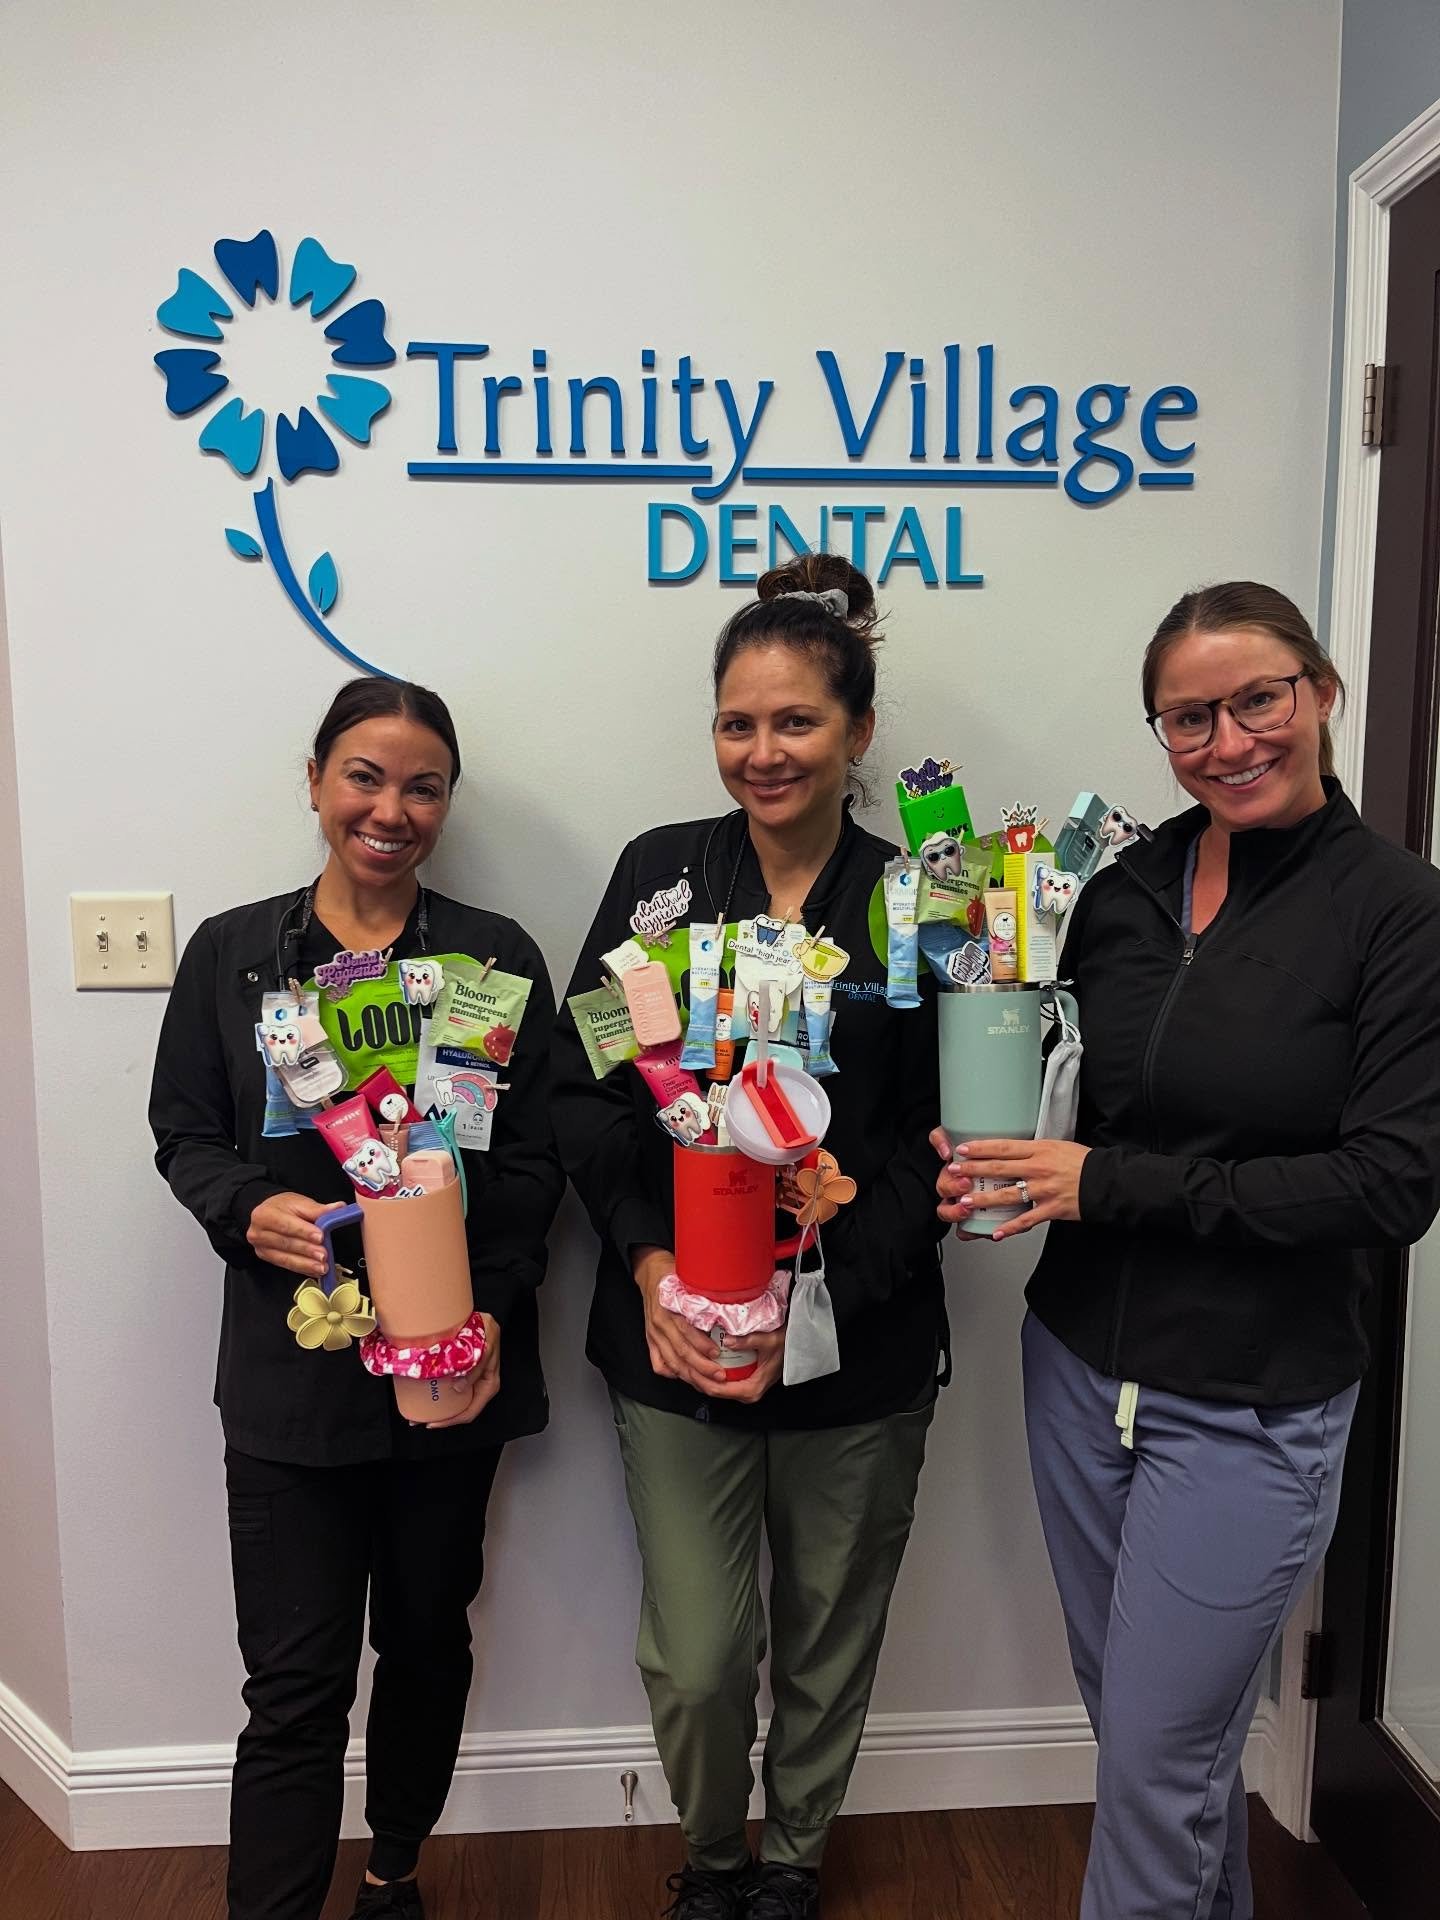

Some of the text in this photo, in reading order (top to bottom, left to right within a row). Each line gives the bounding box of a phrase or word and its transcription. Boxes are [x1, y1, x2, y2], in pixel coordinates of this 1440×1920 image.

[407, 342, 1197, 504] Trinity Village
[648, 502, 983, 584] DENTAL
[728, 940, 754, 953] Dental
[455, 981, 497, 1005] Bloom
[450, 1006, 490, 1022] gummies
[452, 998, 508, 1018] supergreens
[987, 1024, 1031, 1035] STANLEY
[712, 1184, 758, 1196] STANLEY
